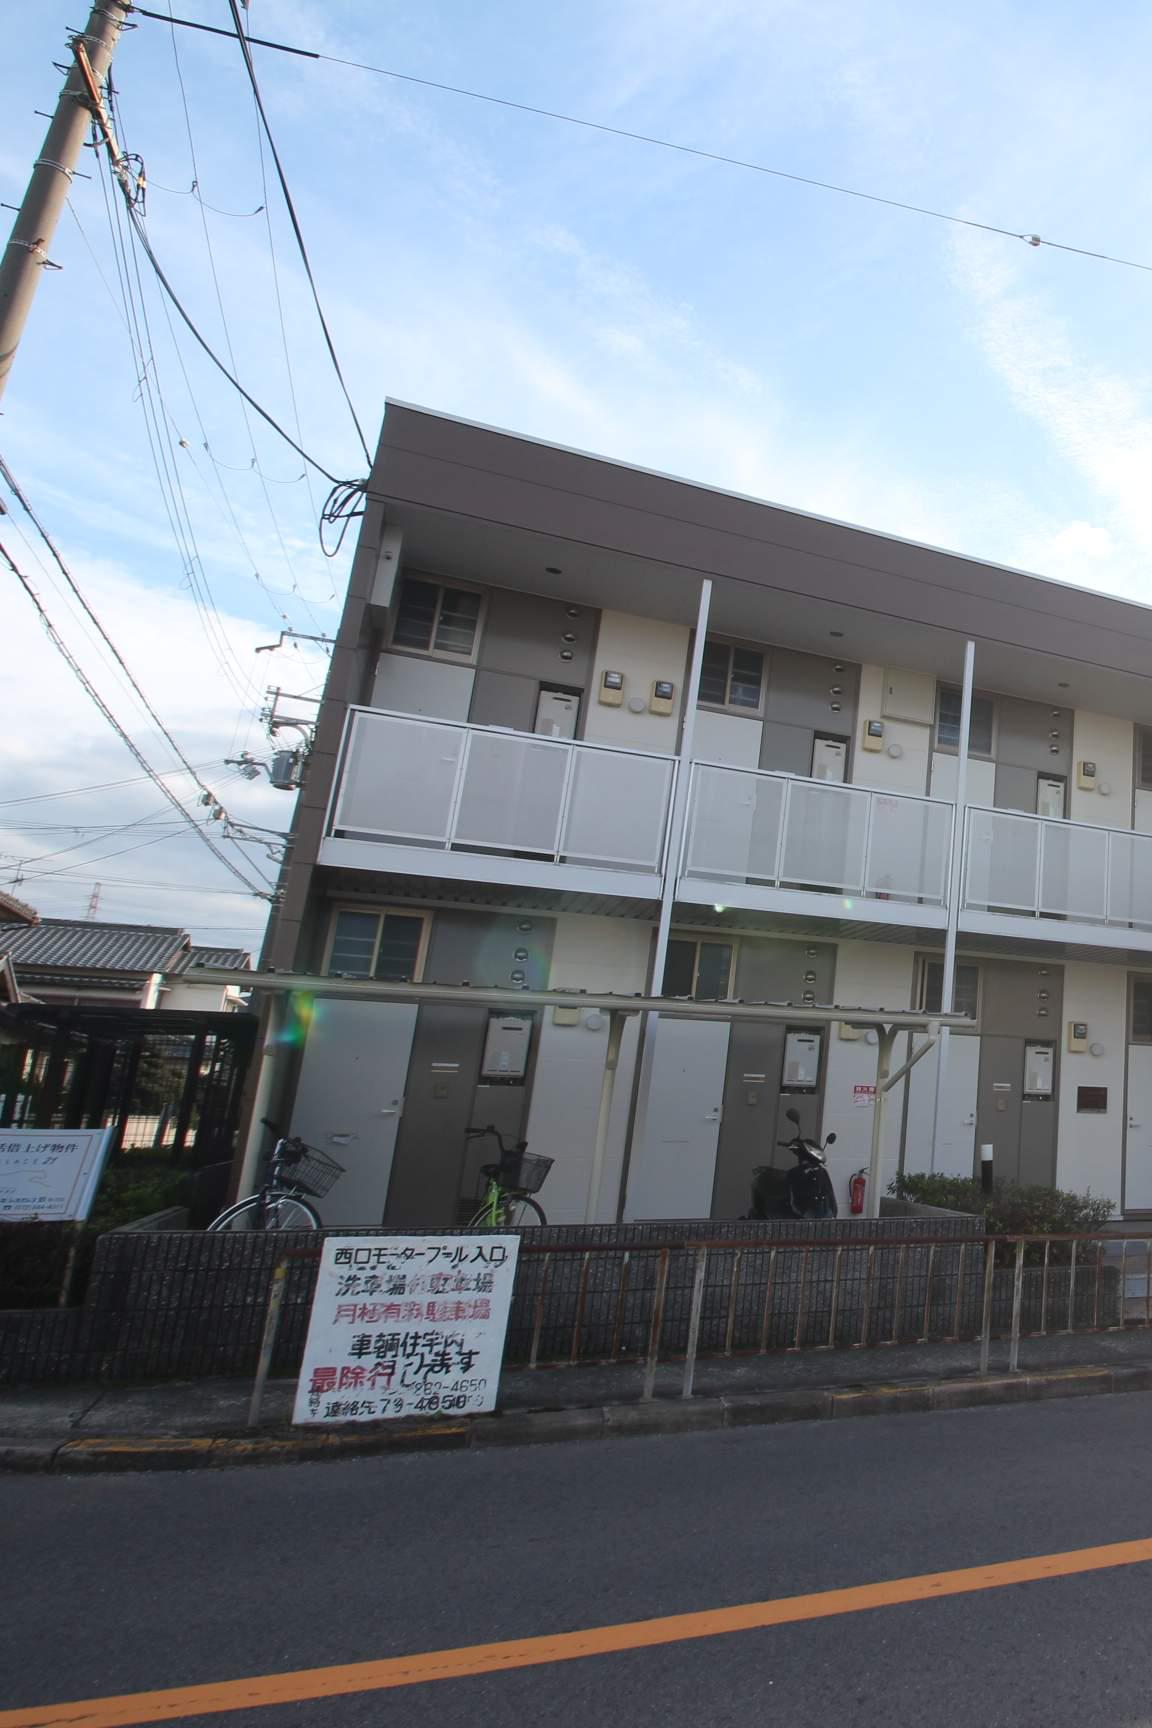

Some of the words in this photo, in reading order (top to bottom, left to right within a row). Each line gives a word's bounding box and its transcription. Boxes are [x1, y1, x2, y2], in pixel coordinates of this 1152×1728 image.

[334, 1246, 507, 1265] 西口モータープール入口
